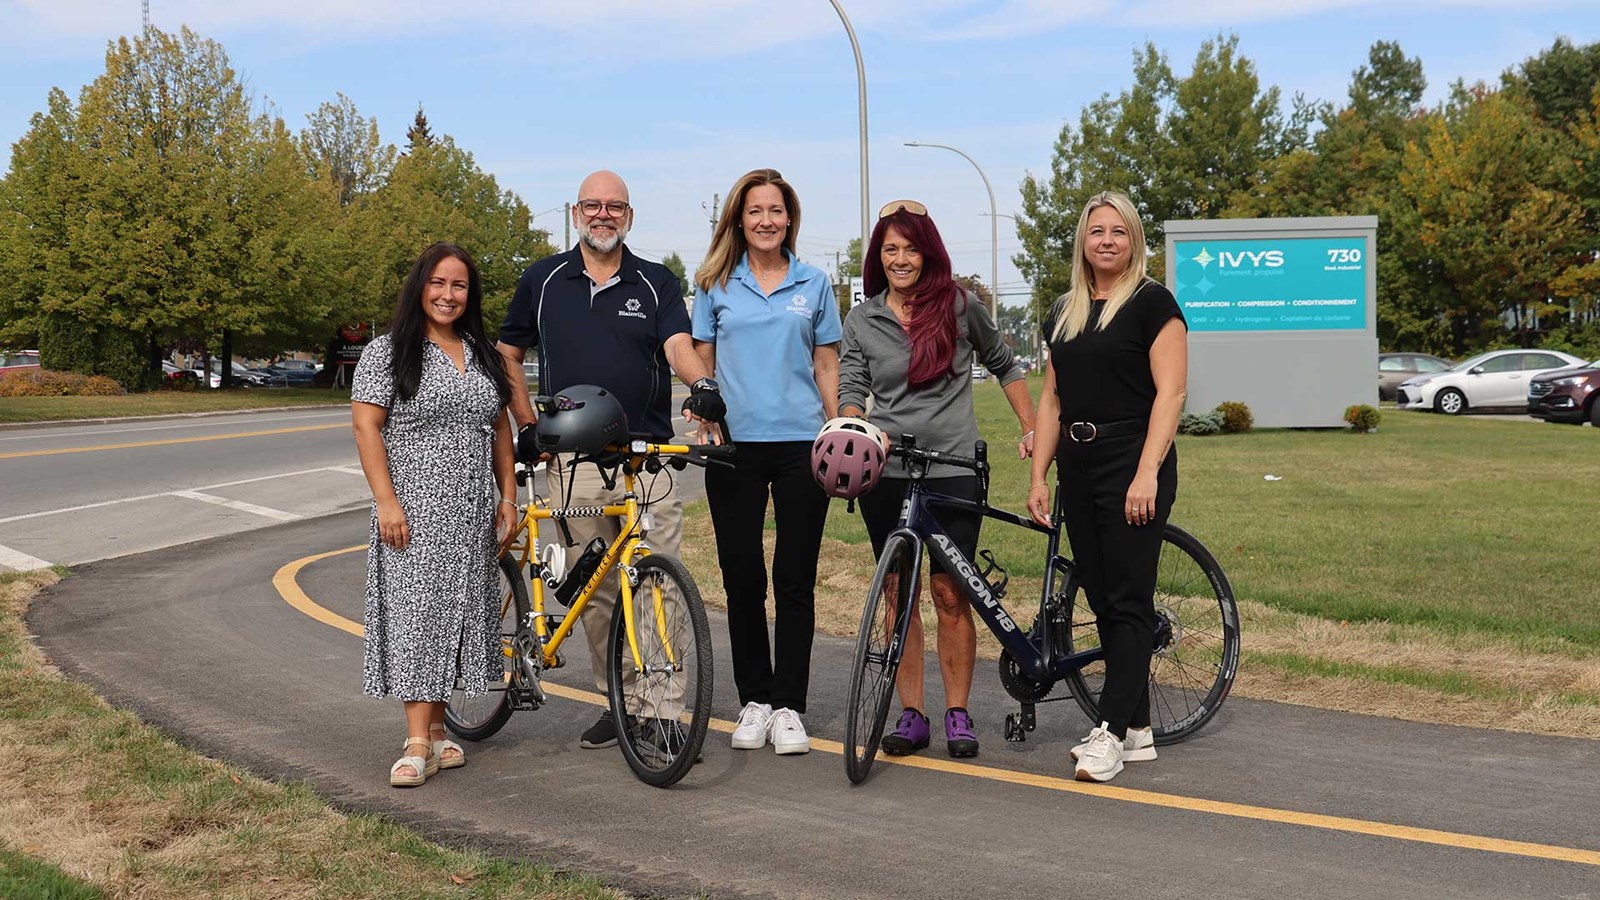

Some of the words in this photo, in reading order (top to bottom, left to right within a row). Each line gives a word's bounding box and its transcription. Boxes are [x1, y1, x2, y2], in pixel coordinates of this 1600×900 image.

[1219, 250, 1285, 268] IVYS
[1327, 249, 1362, 263] 730
[931, 533, 998, 609] ARGON
[995, 607, 1016, 633] 18
